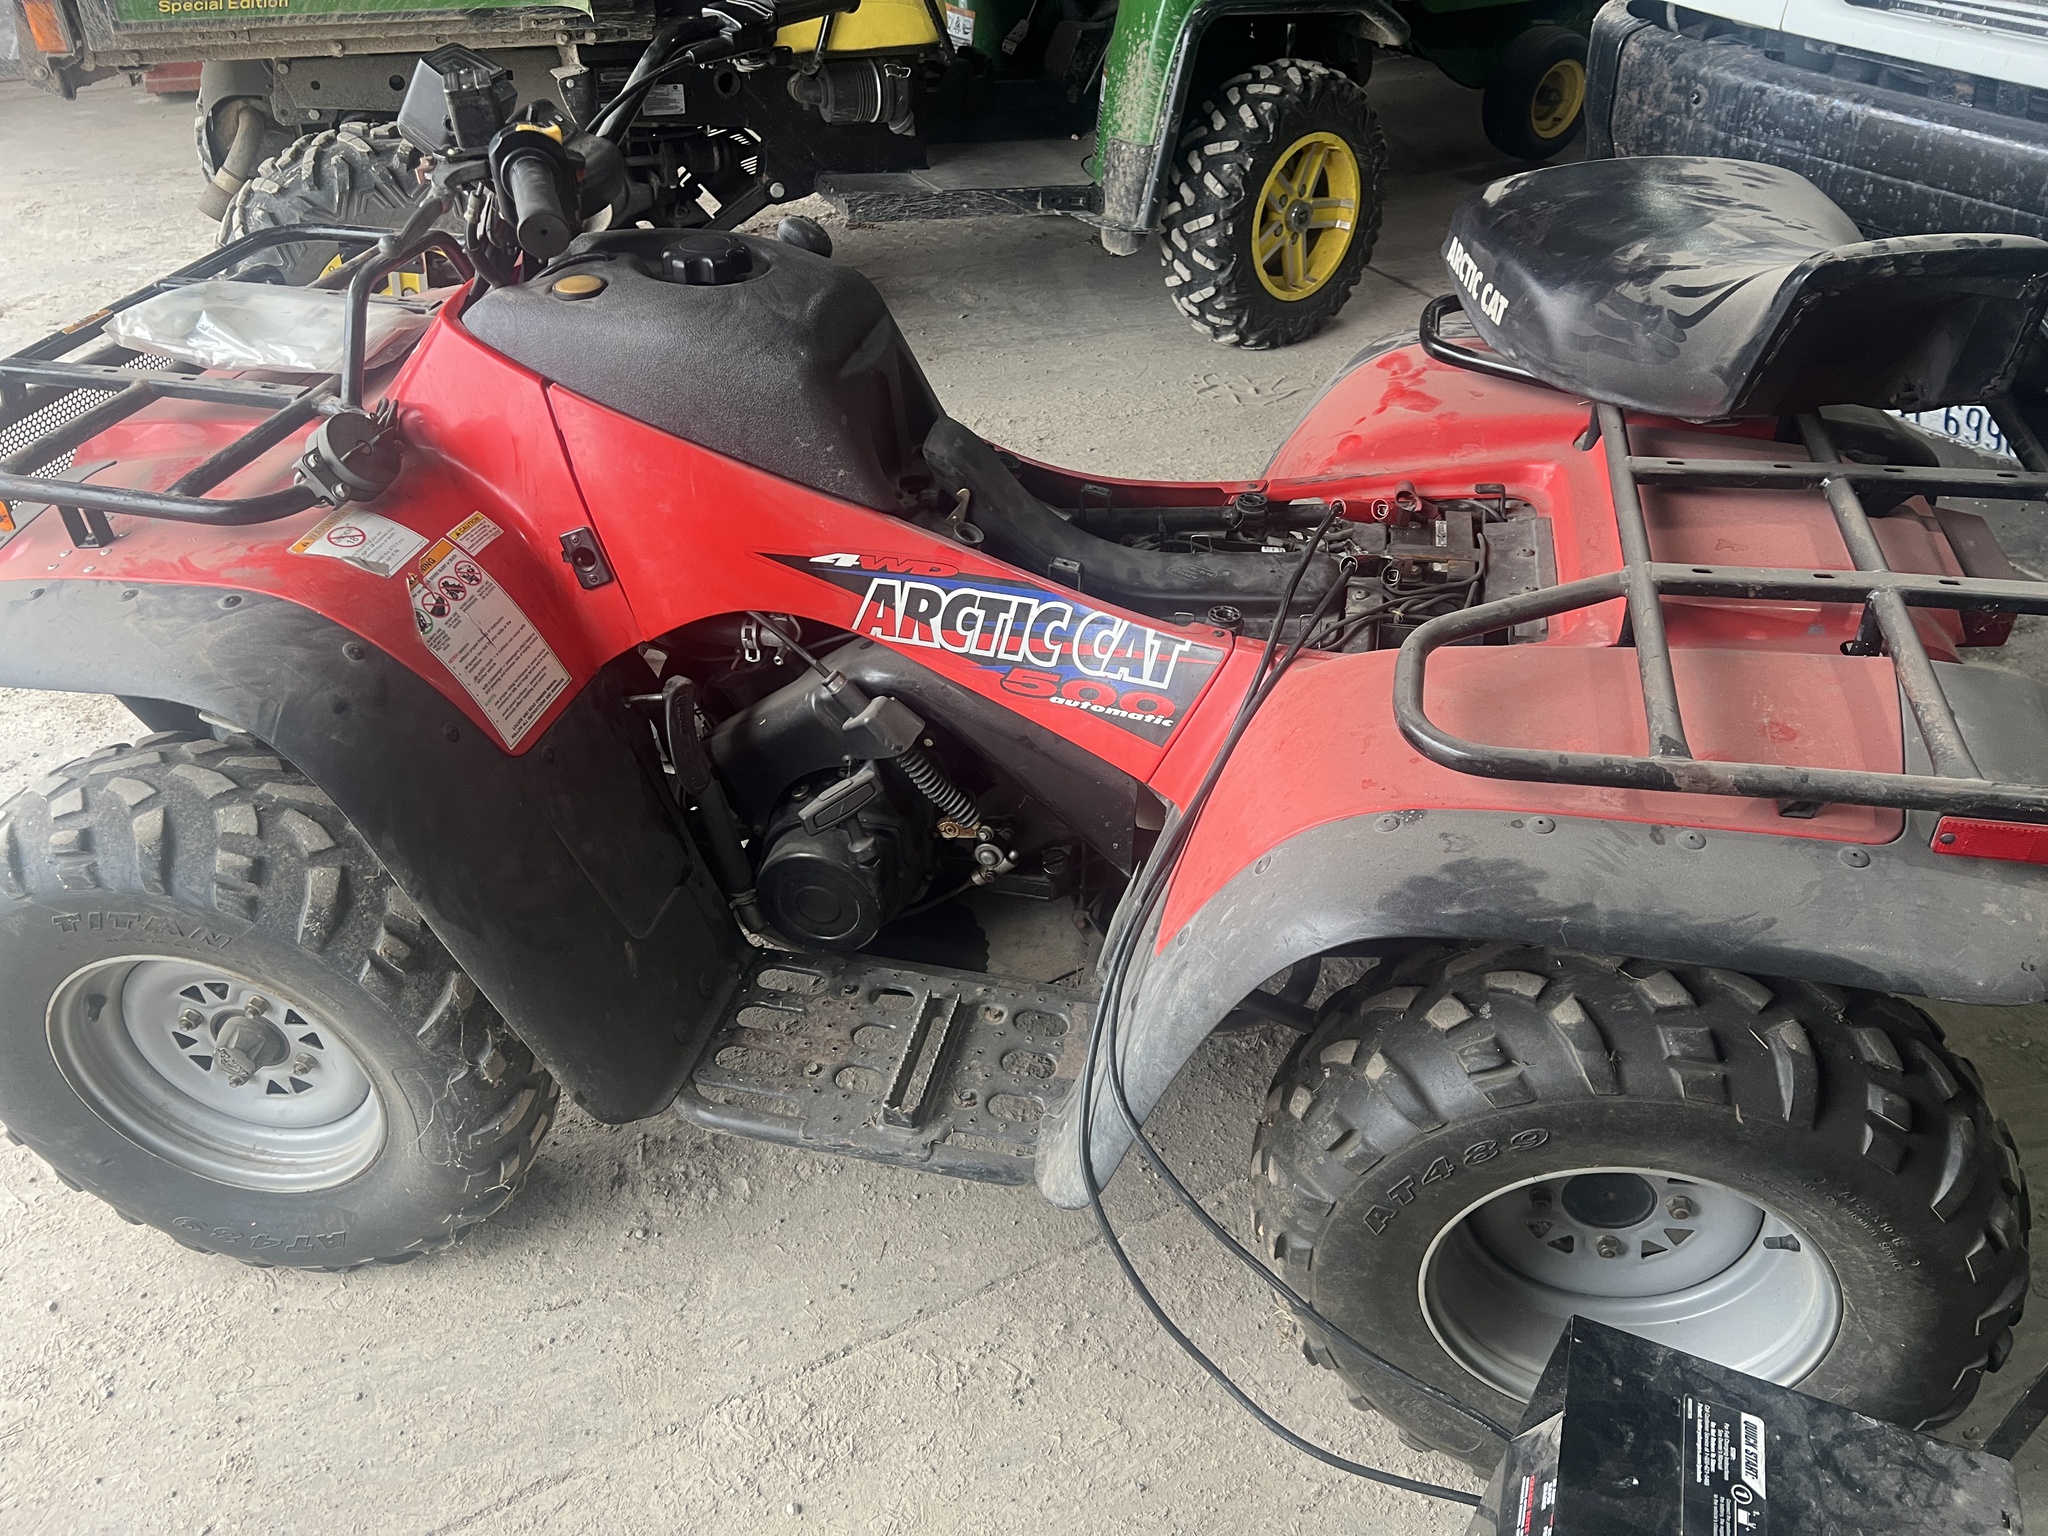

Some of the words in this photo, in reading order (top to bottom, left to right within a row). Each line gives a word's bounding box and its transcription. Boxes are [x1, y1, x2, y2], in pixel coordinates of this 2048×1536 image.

[158, 0, 223, 14] Special
[228, 0, 289, 10] Edition
[1446, 236, 1484, 300] ARCTIC
[1480, 283, 1509, 326] CAT
[1944, 406, 2012, 456] 699
[309, 511, 348, 541] WARNING
[458, 515, 480, 533] CAUTION
[421, 557, 436, 573] NING
[809, 552, 960, 577] 4WD
[851, 578, 1073, 667] ARCTIC
[1072, 611, 1190, 690] CAT
[1000, 667, 1177, 720] 500
[1048, 694, 1175, 728] automatic
[50, 910, 234, 950] TITAN
[1362, 1126, 1552, 1235] AT489
[171, 1214, 348, 1255] AT489
[1743, 1420, 1758, 1450] QUICK
[1744, 1448, 1759, 1480] START:
